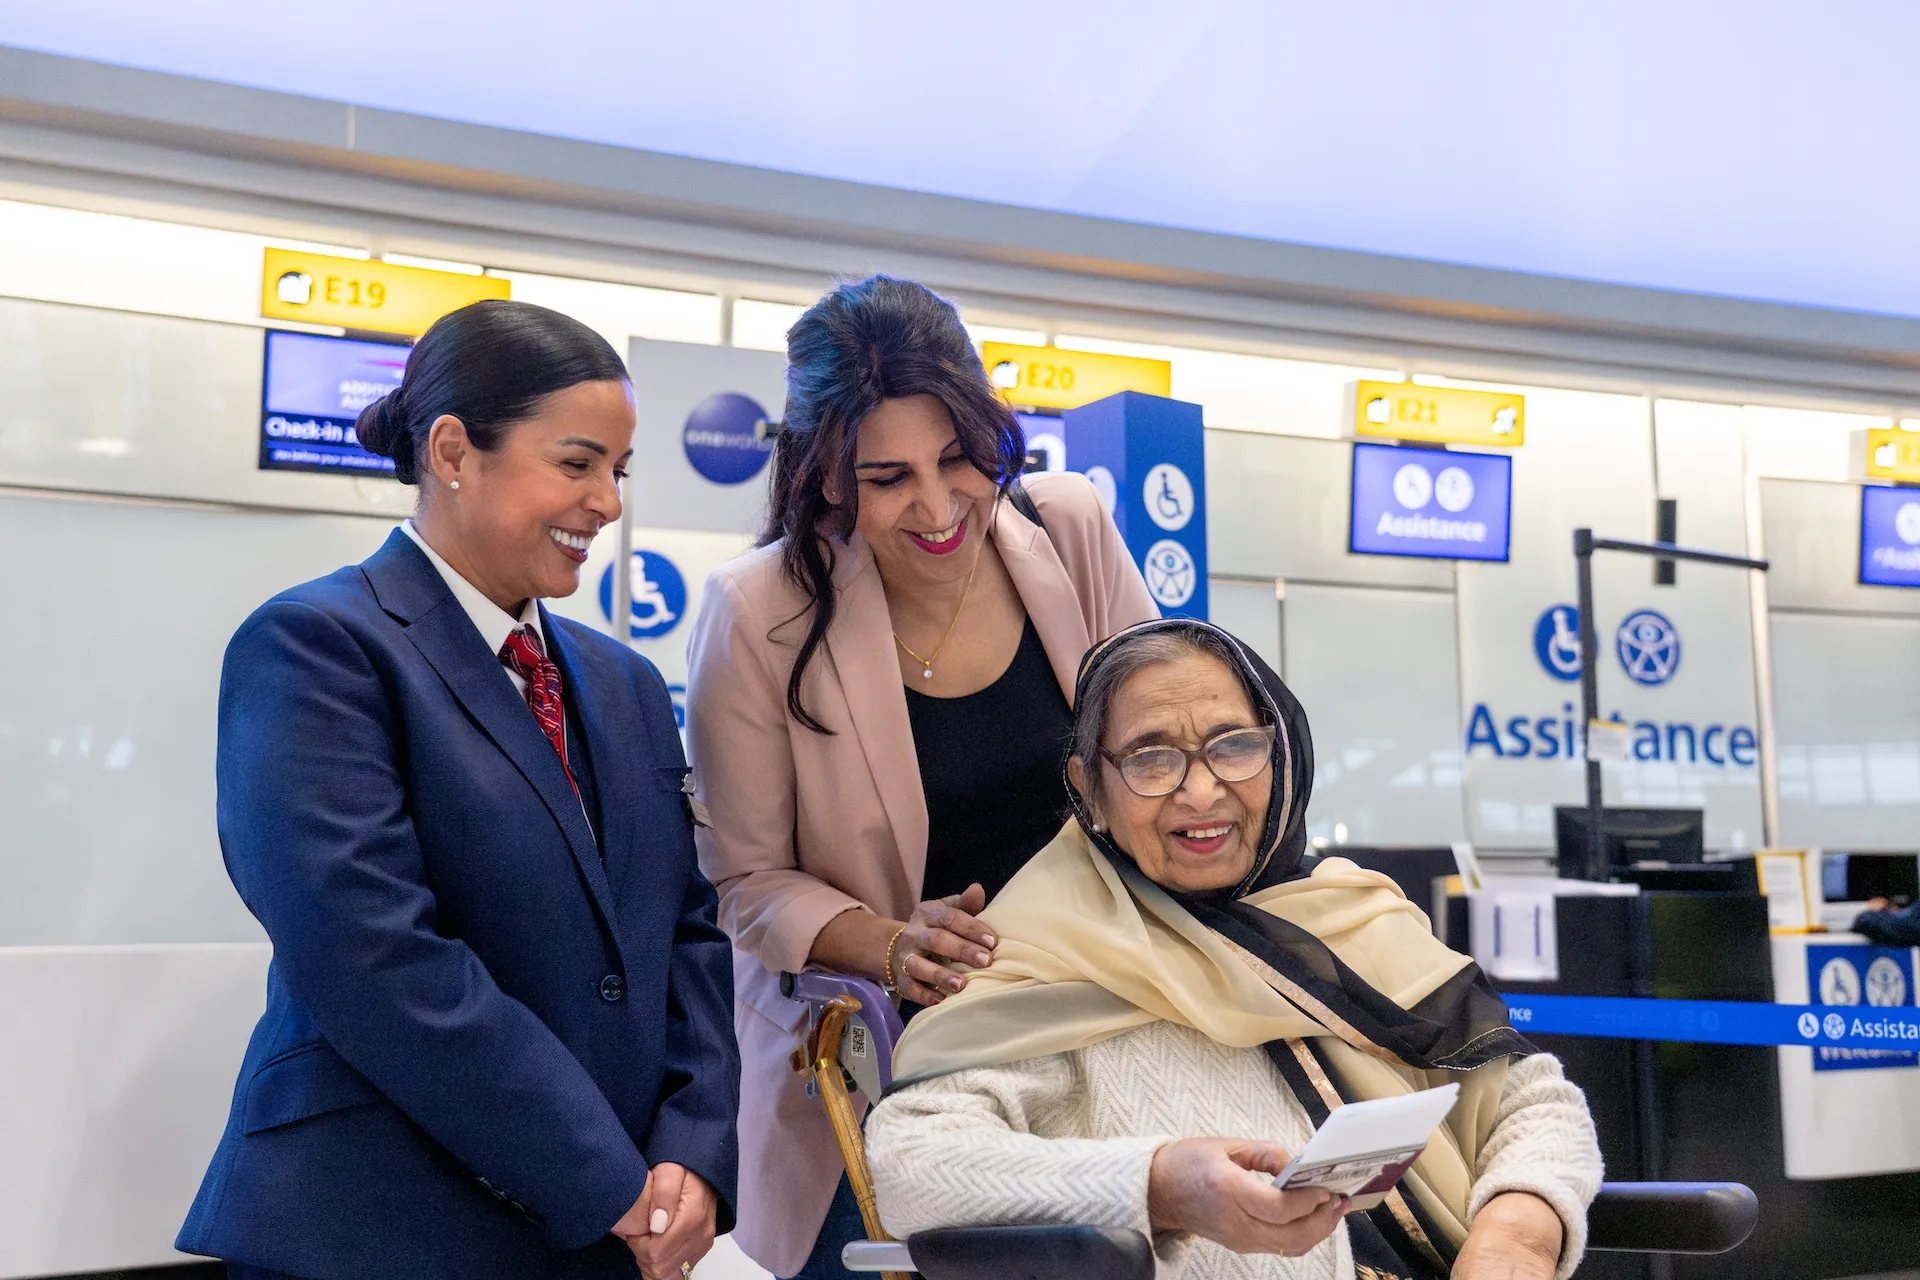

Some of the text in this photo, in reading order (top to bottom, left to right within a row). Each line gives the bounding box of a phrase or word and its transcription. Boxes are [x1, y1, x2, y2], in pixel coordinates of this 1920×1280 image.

[325, 275, 386, 310] E19
[1027, 362, 1076, 391] E20
[1396, 398, 1438, 424] E21
[265, 416, 344, 442] Check-in
[1376, 511, 1487, 542] Assistance
[1465, 702, 1757, 766] Assiance
[1850, 1017, 1920, 1040] Assista
